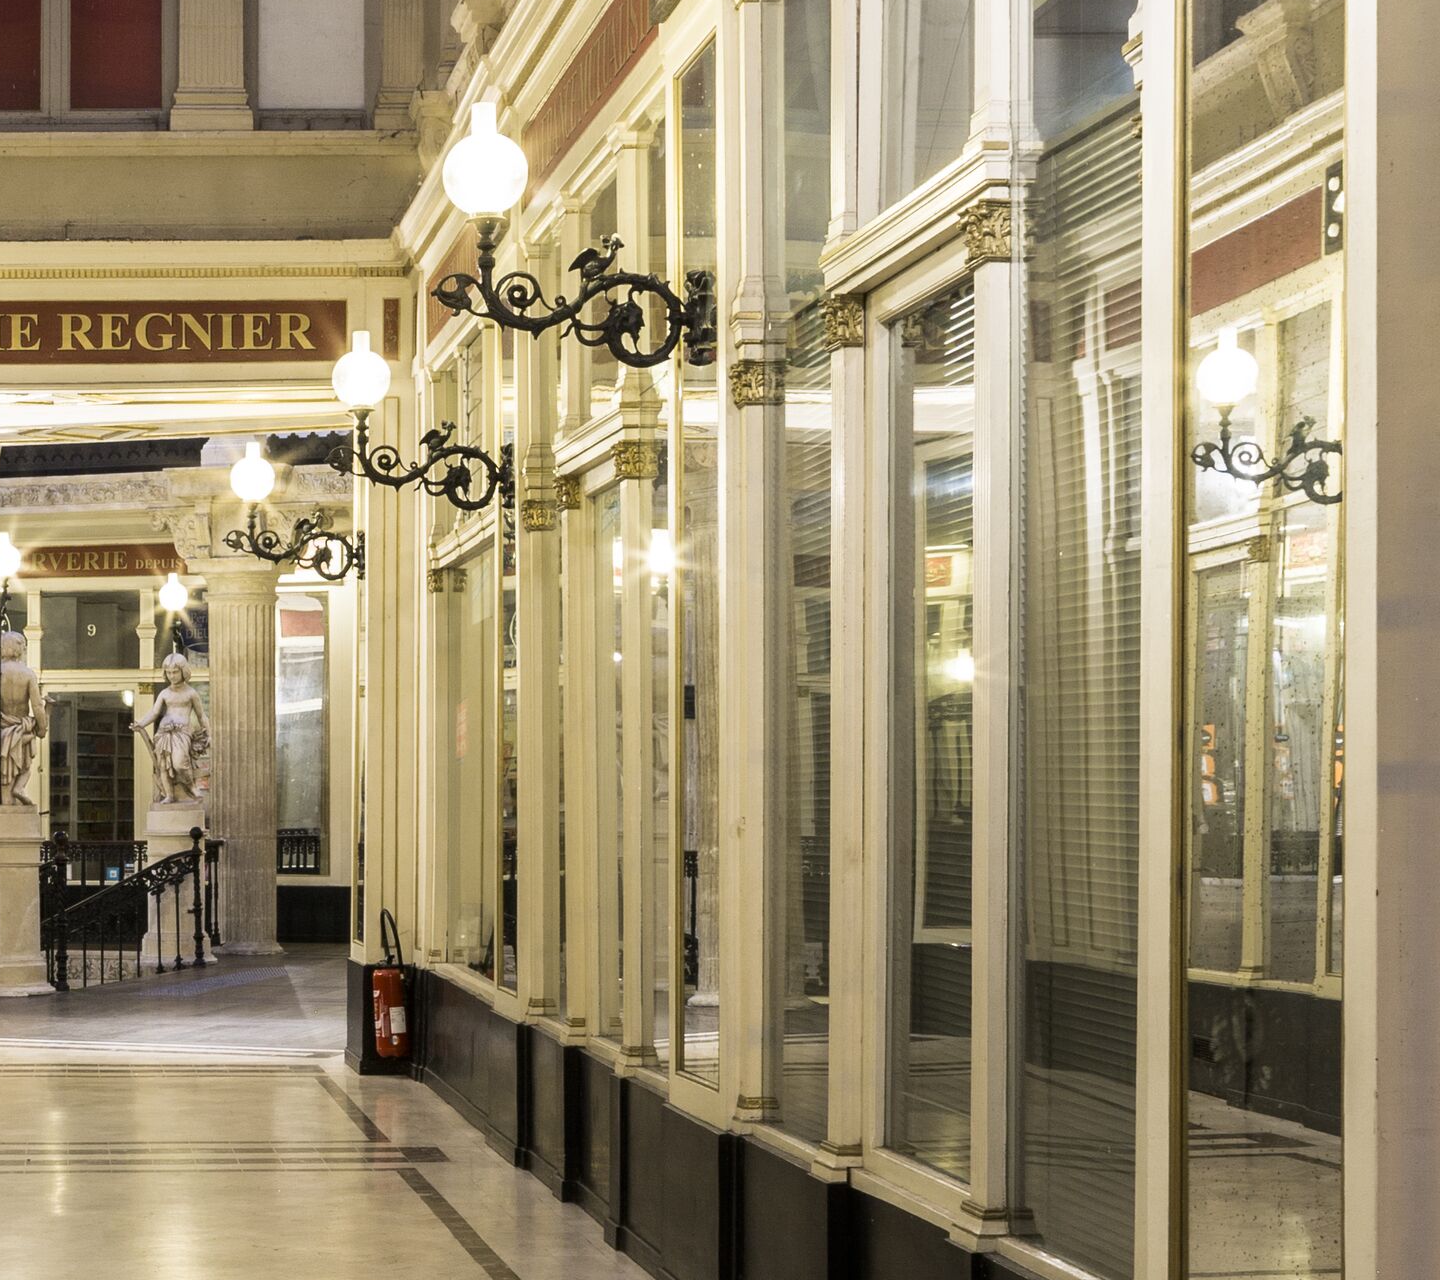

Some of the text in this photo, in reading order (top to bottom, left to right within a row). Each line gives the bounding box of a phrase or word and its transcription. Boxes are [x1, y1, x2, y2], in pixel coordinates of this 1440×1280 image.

[57, 312, 317, 352] REGNIER
[135, 558, 183, 570] DEPUIS
[86, 624, 97, 637] 9
